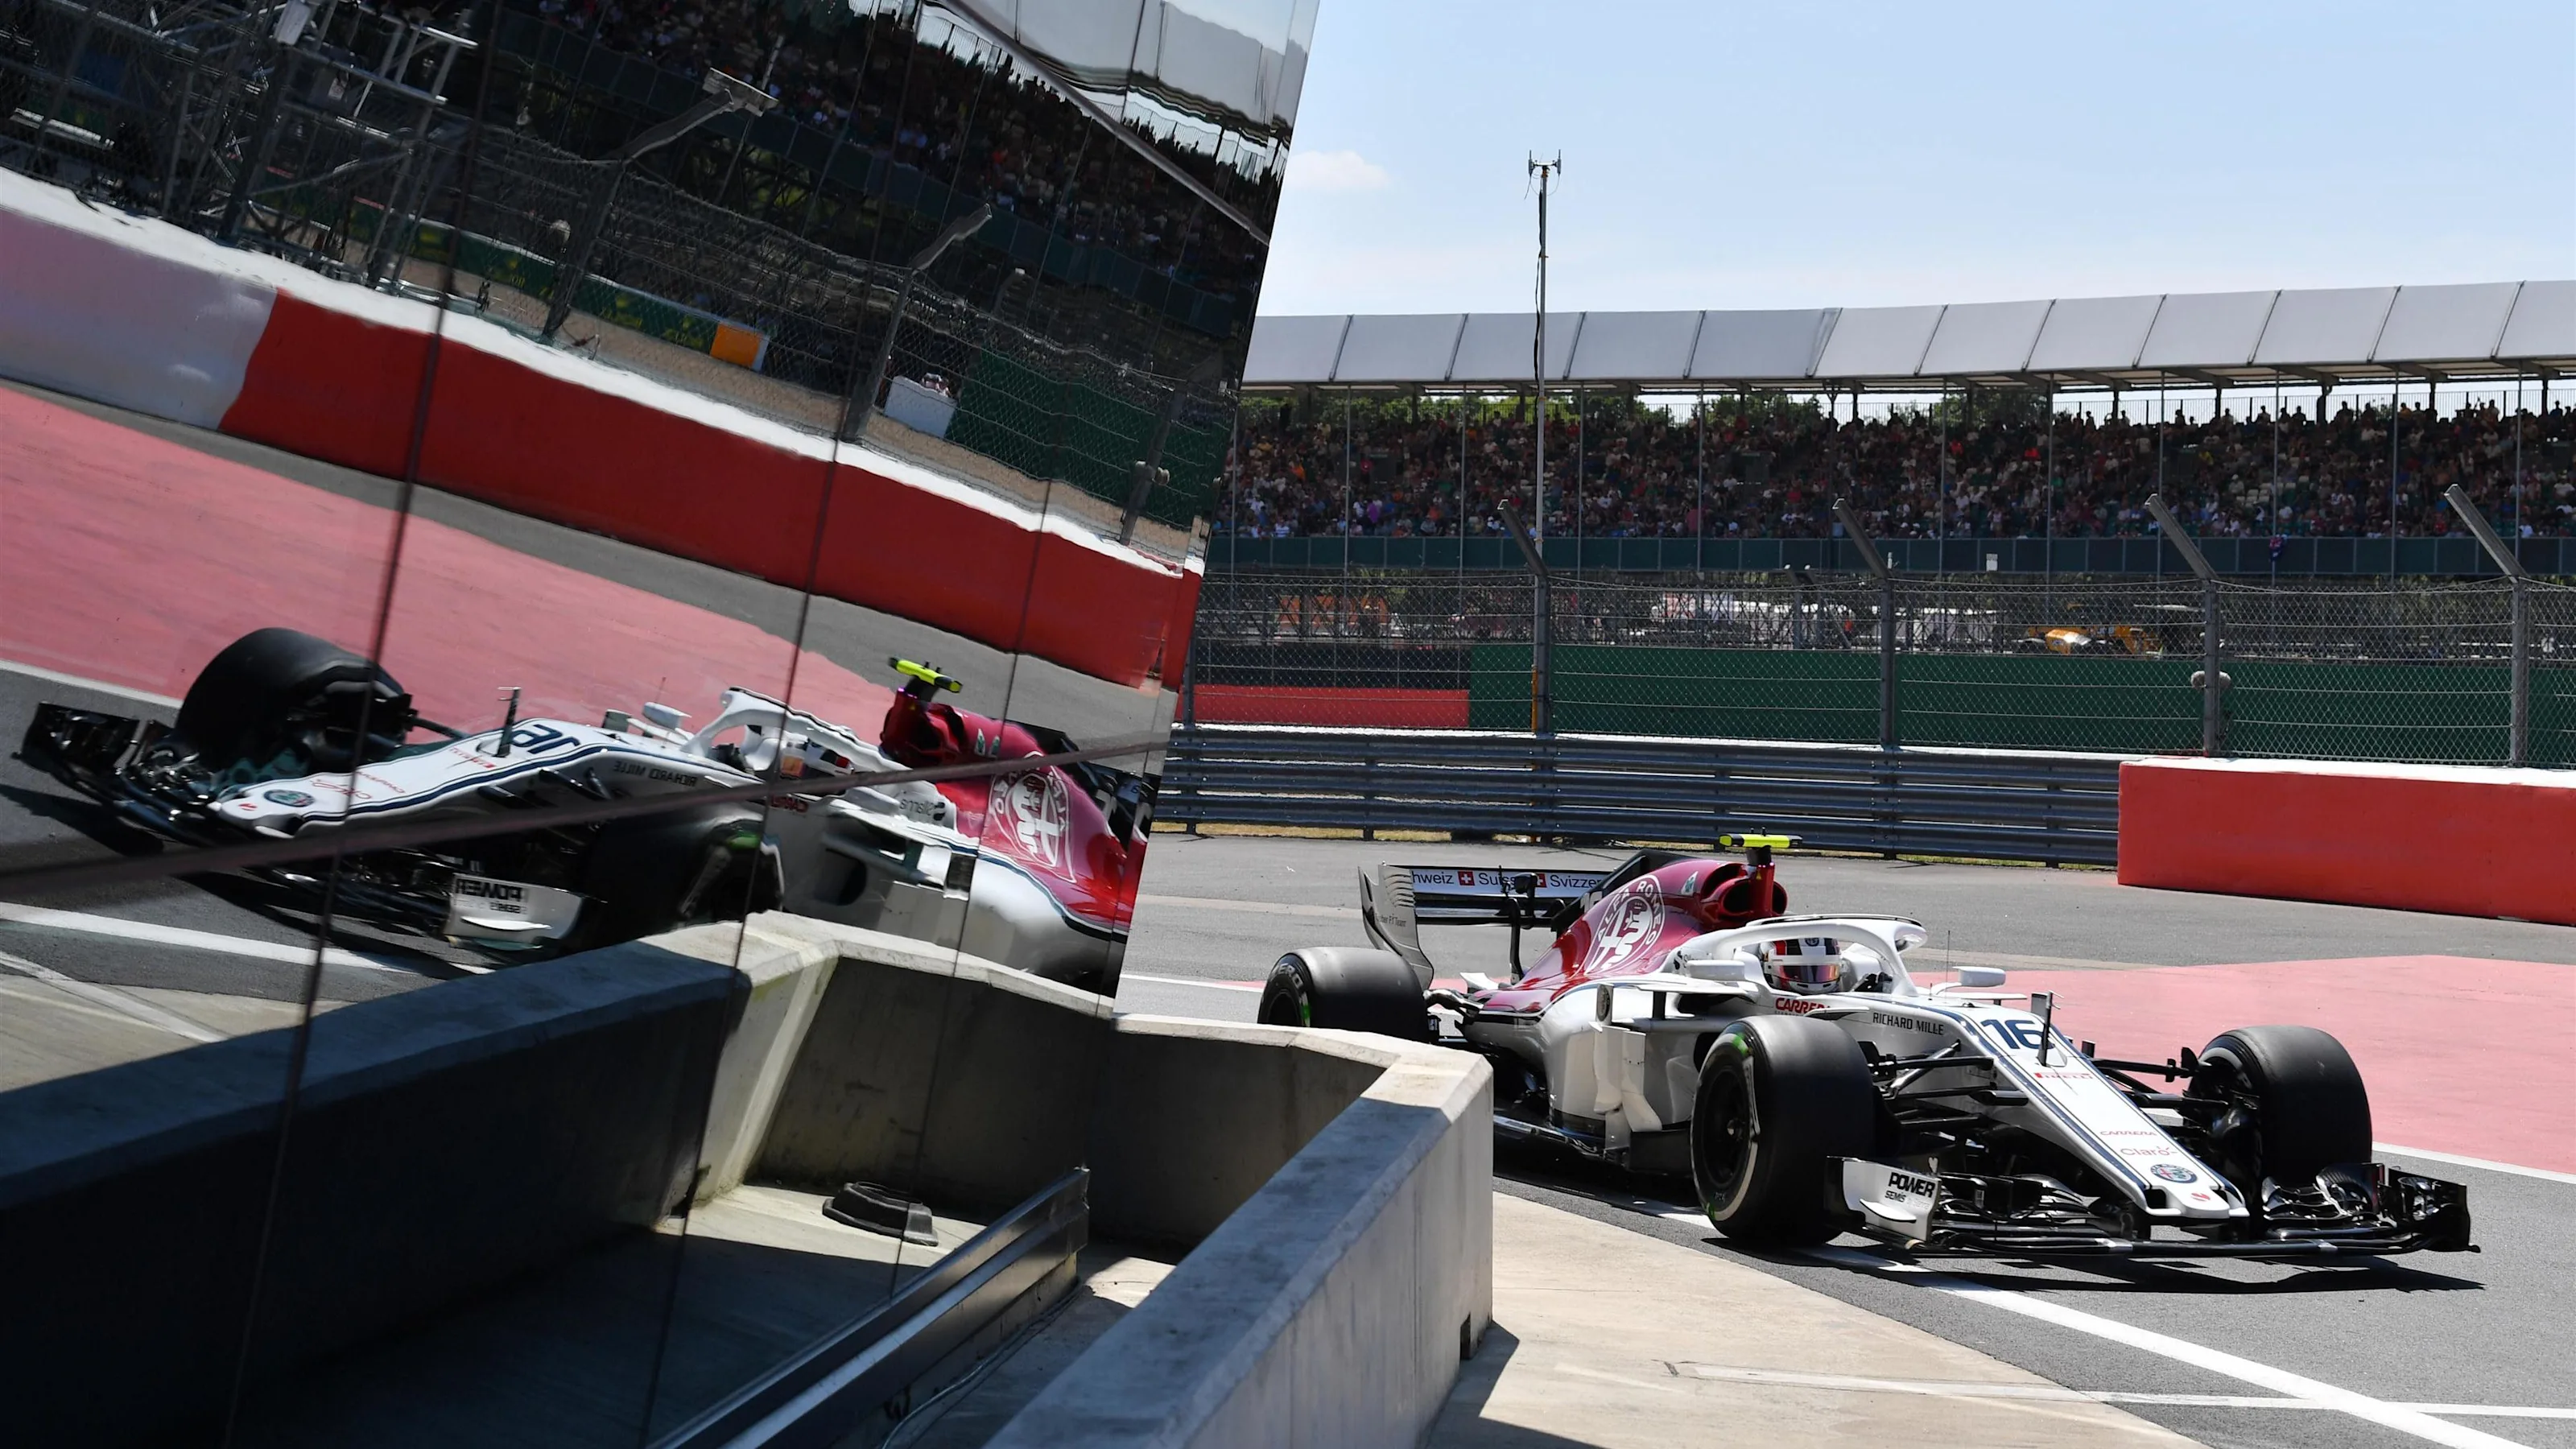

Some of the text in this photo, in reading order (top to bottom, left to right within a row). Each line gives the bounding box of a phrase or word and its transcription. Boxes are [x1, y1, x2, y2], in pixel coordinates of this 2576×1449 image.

[1598, 880, 1662, 946] ALFA ROMEO
[1872, 1013, 1944, 1036] RICHARD MILLE
[1980, 1018, 2056, 1050] 16
[1888, 1172, 1935, 1198] POWER
